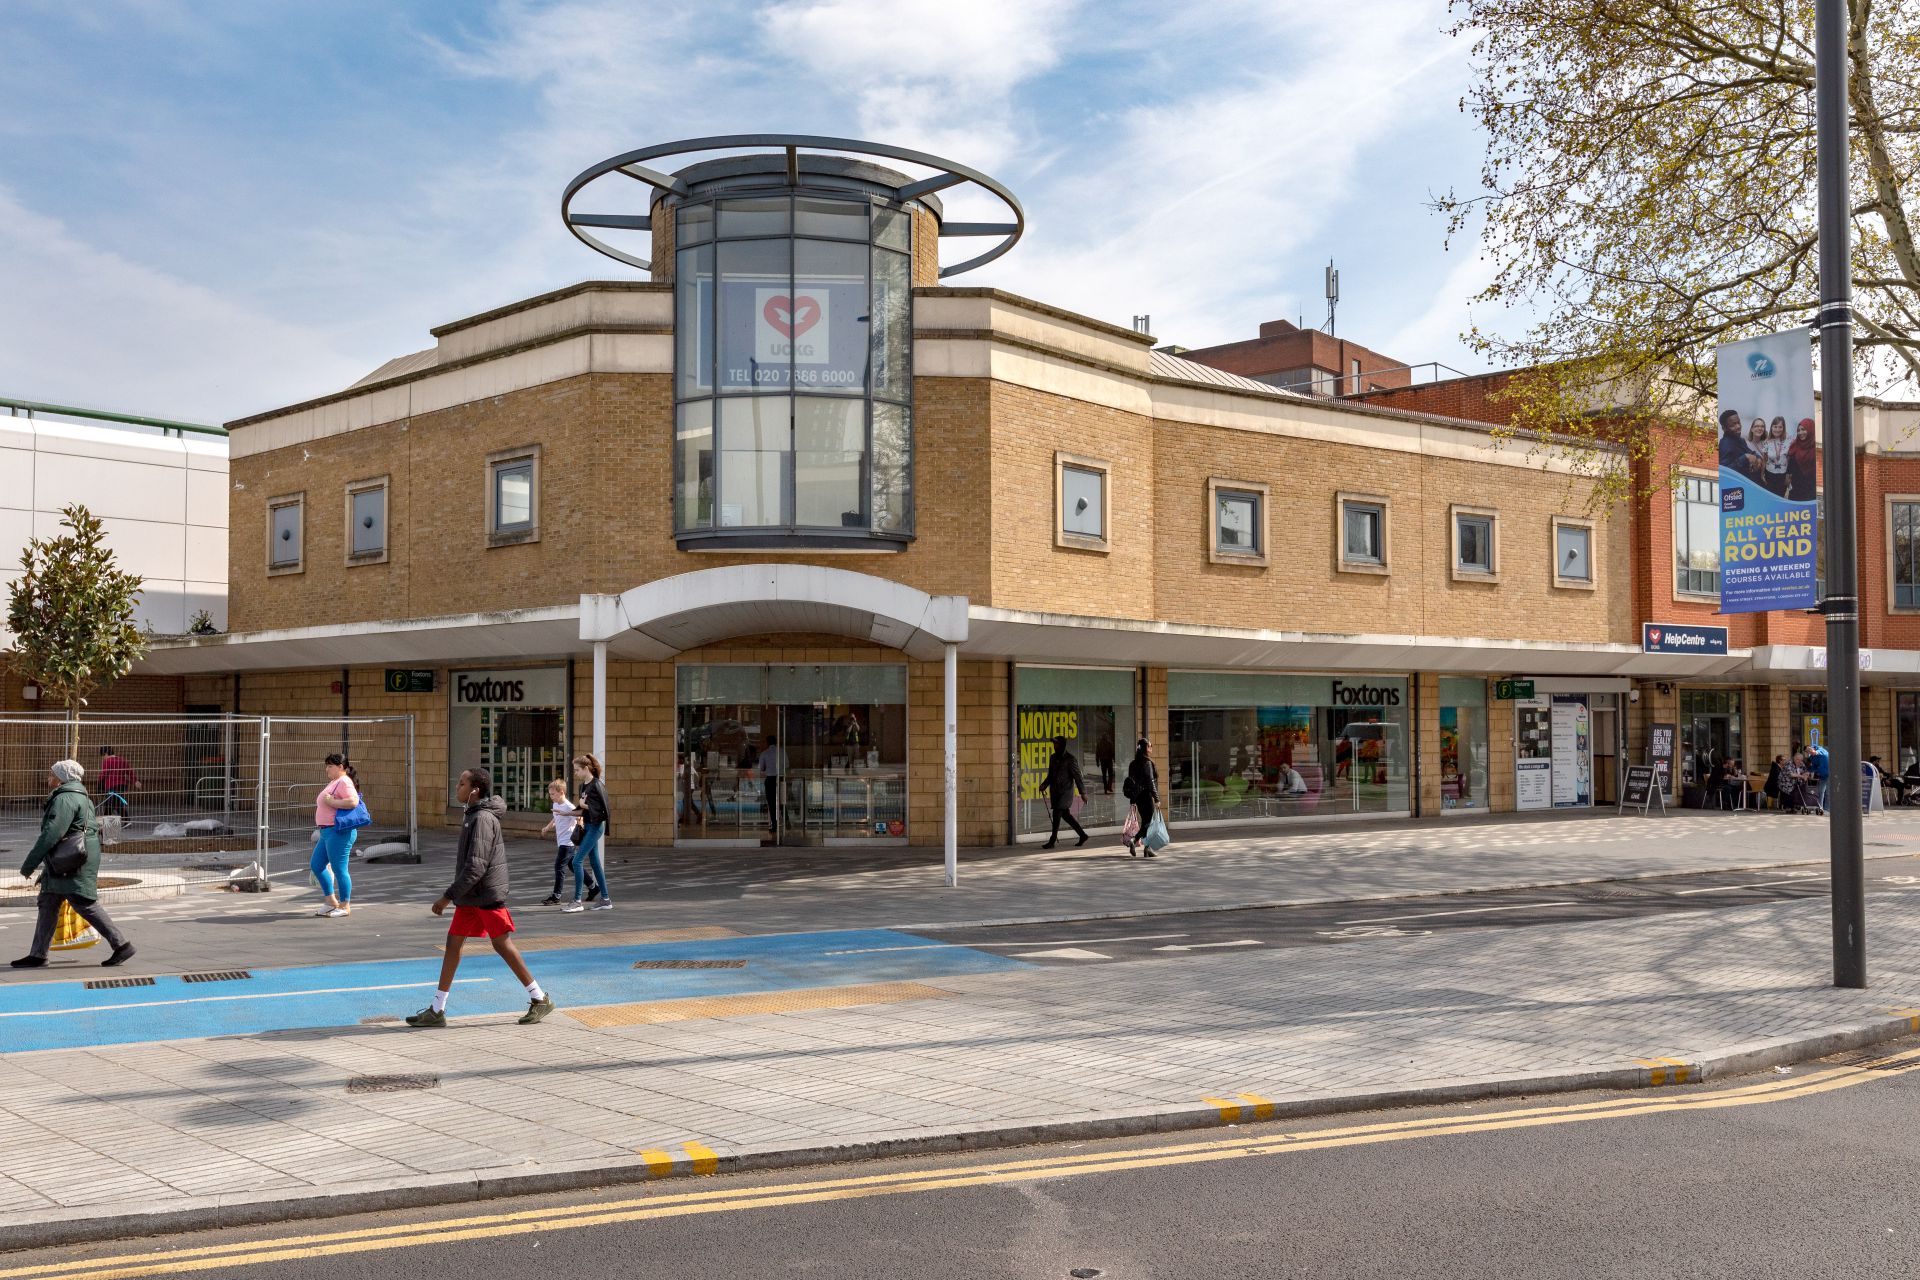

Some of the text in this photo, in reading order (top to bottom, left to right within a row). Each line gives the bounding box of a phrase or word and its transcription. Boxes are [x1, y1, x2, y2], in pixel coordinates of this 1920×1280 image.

[729, 369, 751, 381] TEL
[755, 369, 780, 382] 020
[821, 370, 855, 382] 6000
[1725, 509, 1811, 529] ENROLLING
[1725, 523, 1812, 544] ALL YEAR
[1725, 538, 1812, 563] ROUND
[1725, 566, 1761, 576] EVENING
[1770, 563, 1811, 572] WEEKEND
[1725, 571, 1811, 584] COURSES AVAILABLE
[457, 674, 525, 702] Foxtons
[1332, 680, 1400, 705] Foxtons
[1600, 695, 1605, 704] 7
[1020, 711, 1078, 739] MOVERS
[1653, 729, 1672, 737] ARE YOU
[1653, 737, 1671, 745] REALLY
